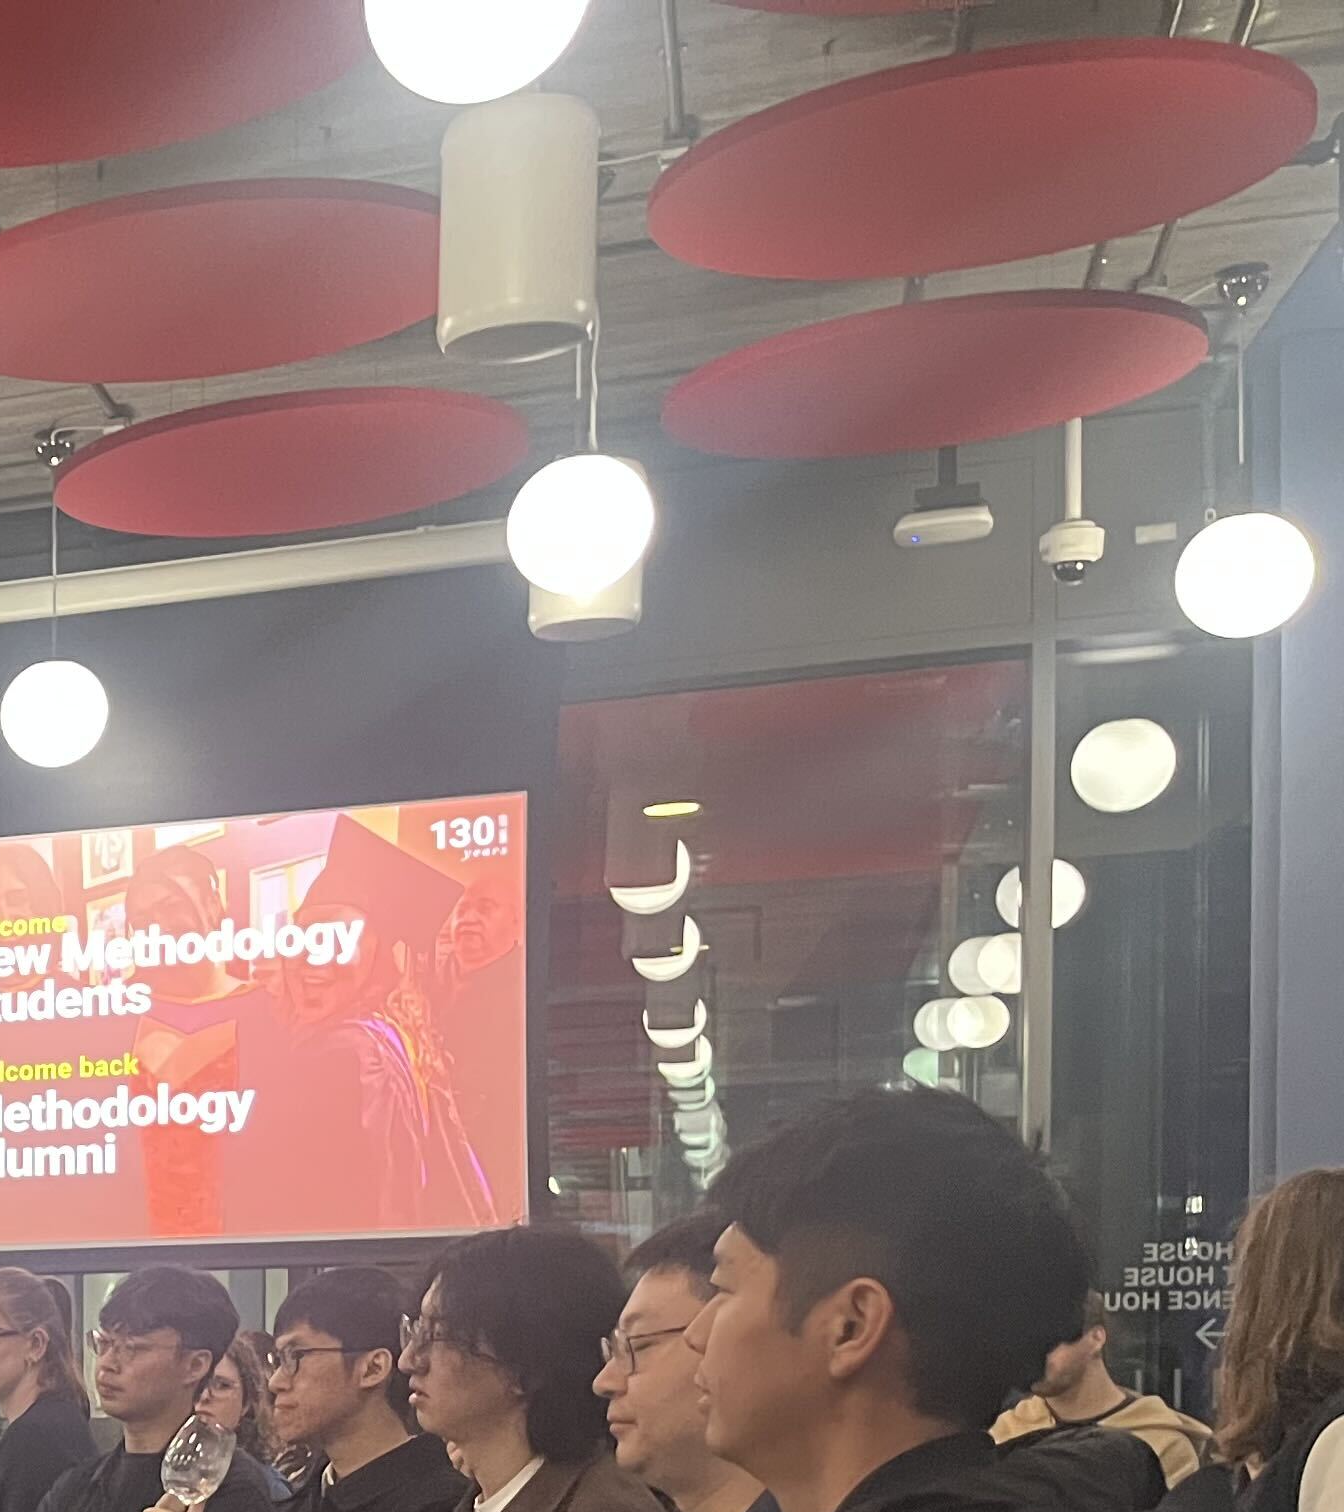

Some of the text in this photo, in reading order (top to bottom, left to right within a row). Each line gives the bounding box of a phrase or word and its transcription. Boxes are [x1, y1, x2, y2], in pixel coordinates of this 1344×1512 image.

[429, 814, 495, 851] 130
[460, 846, 509, 863] years
[60, 914, 365, 974] Methodology
[79, 1052, 140, 1080] back
